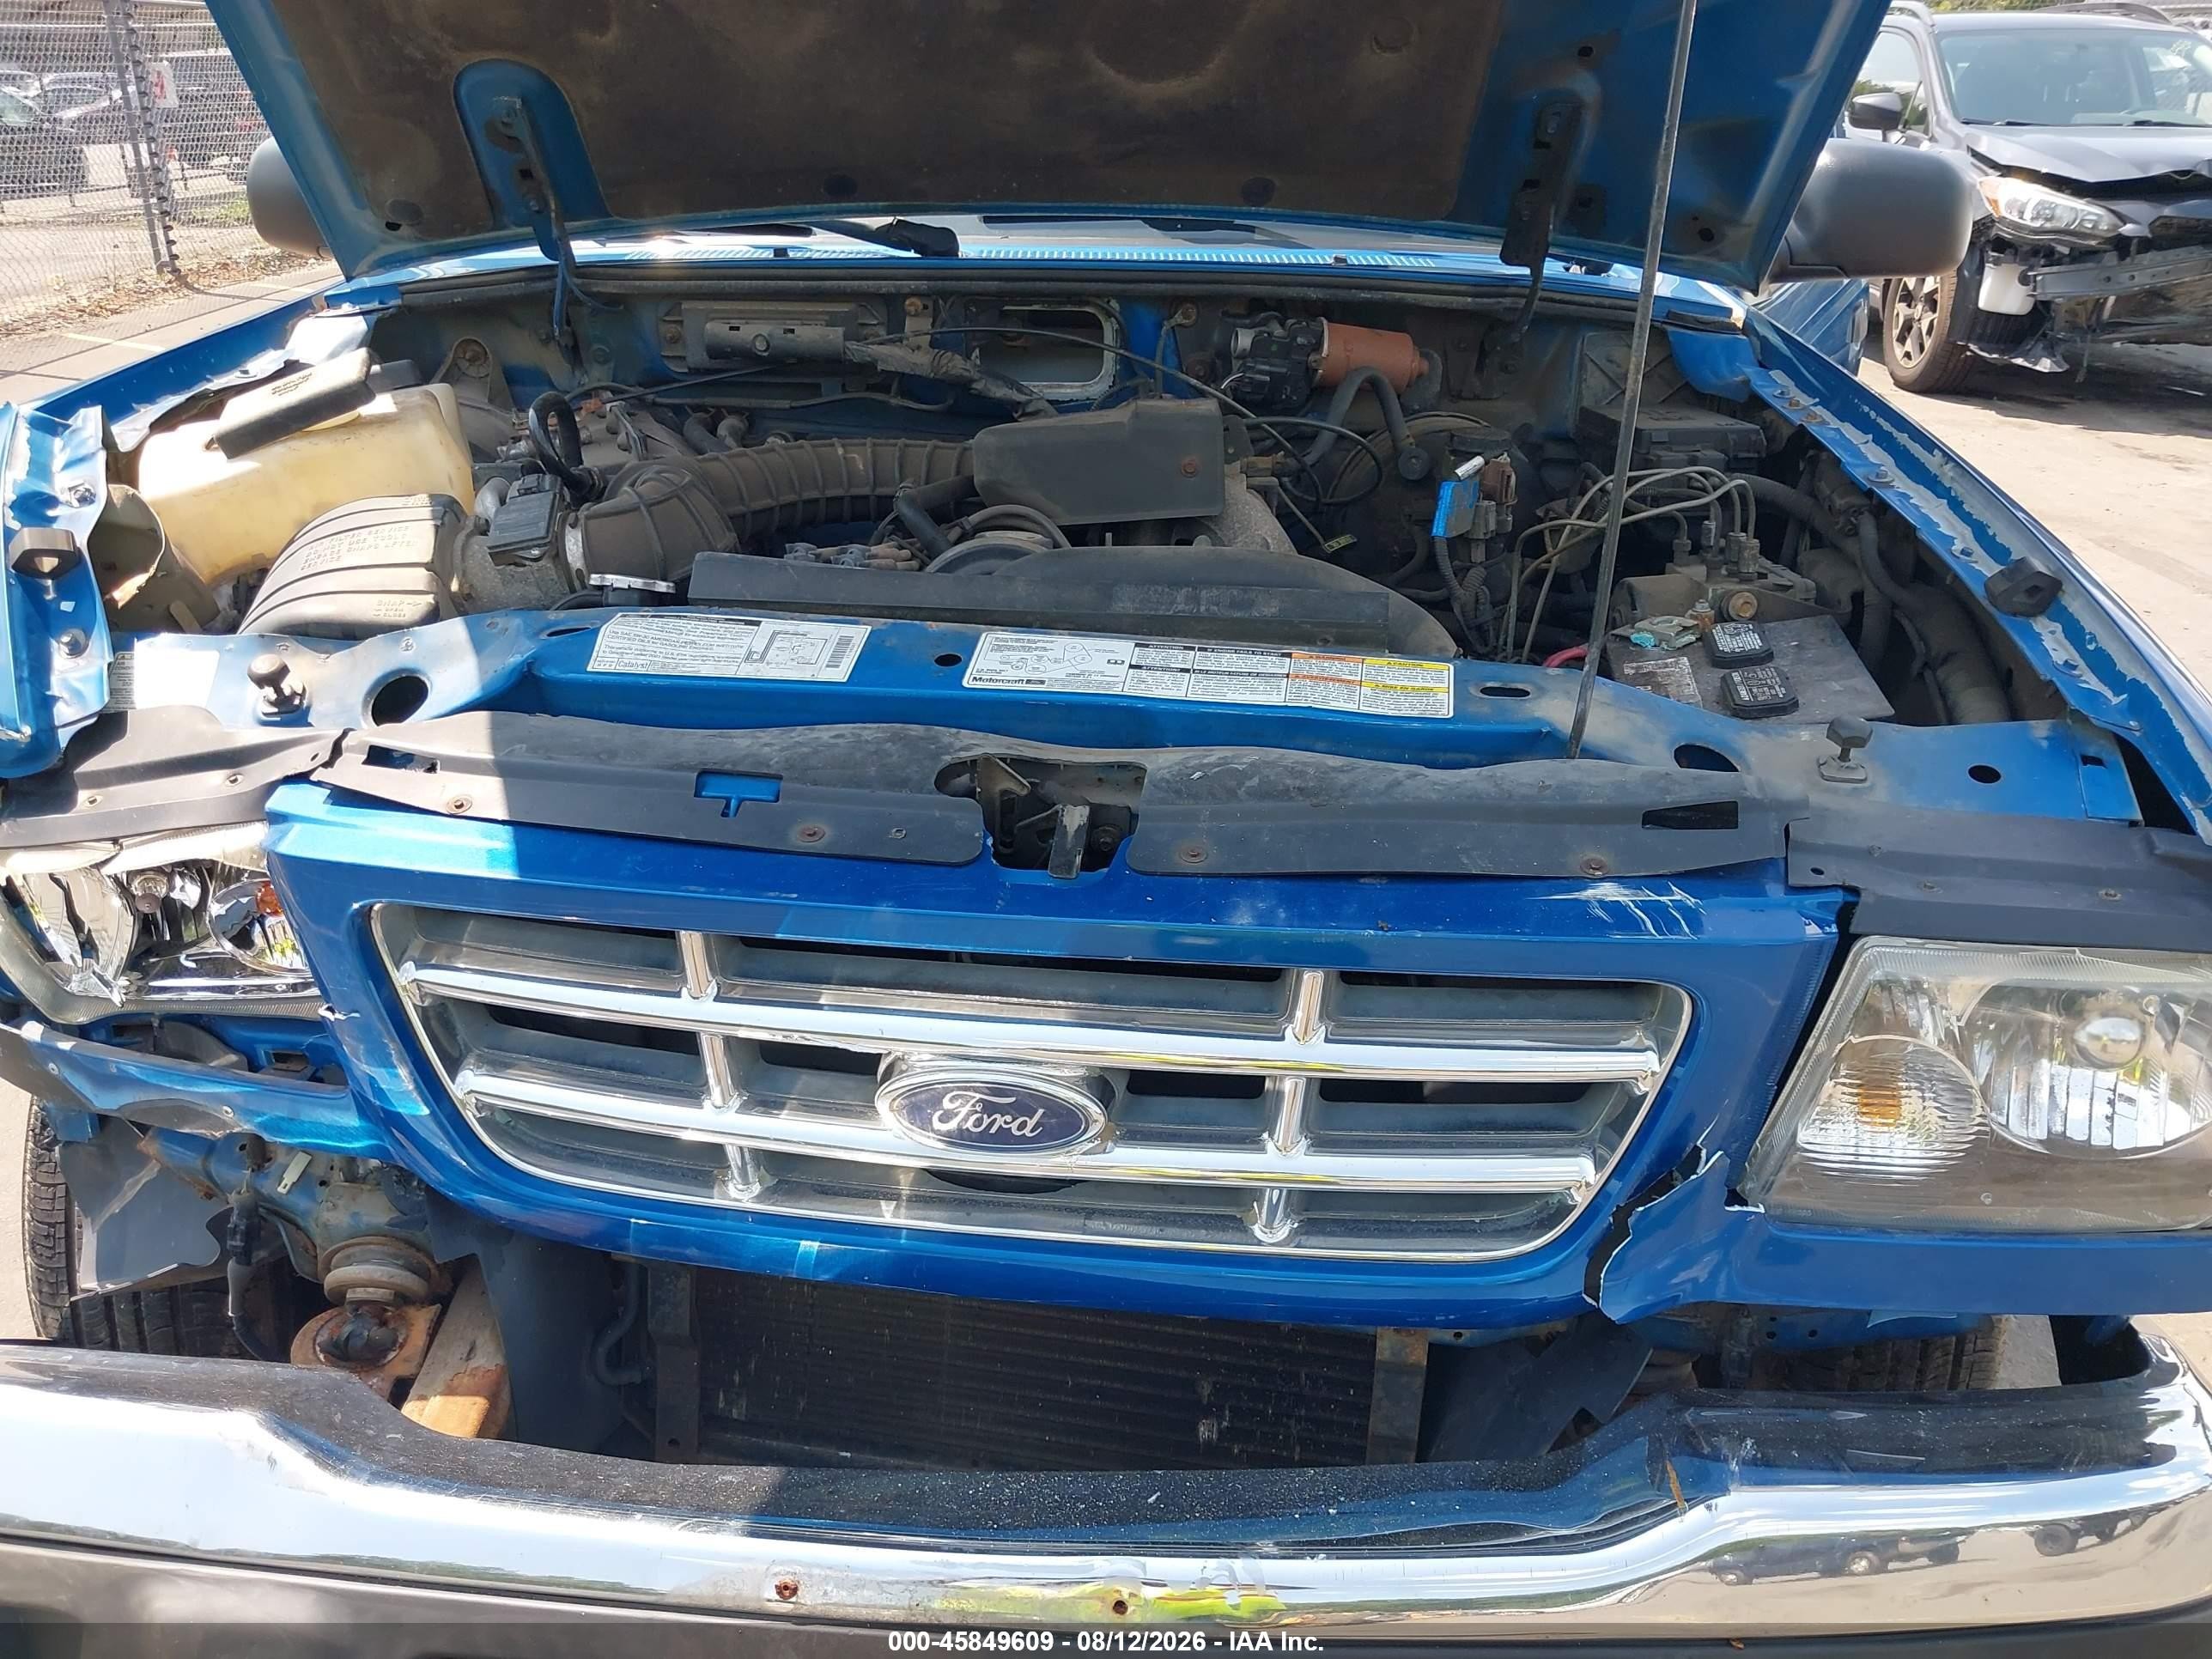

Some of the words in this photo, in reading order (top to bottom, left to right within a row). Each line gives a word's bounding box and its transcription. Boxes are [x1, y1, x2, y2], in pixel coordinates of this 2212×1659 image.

[349, 538, 367, 546] USE
[617, 659, 648, 669] Catalyst
[971, 676, 1025, 684] Motorcraft
[932, 1091, 1045, 1137] Ford
